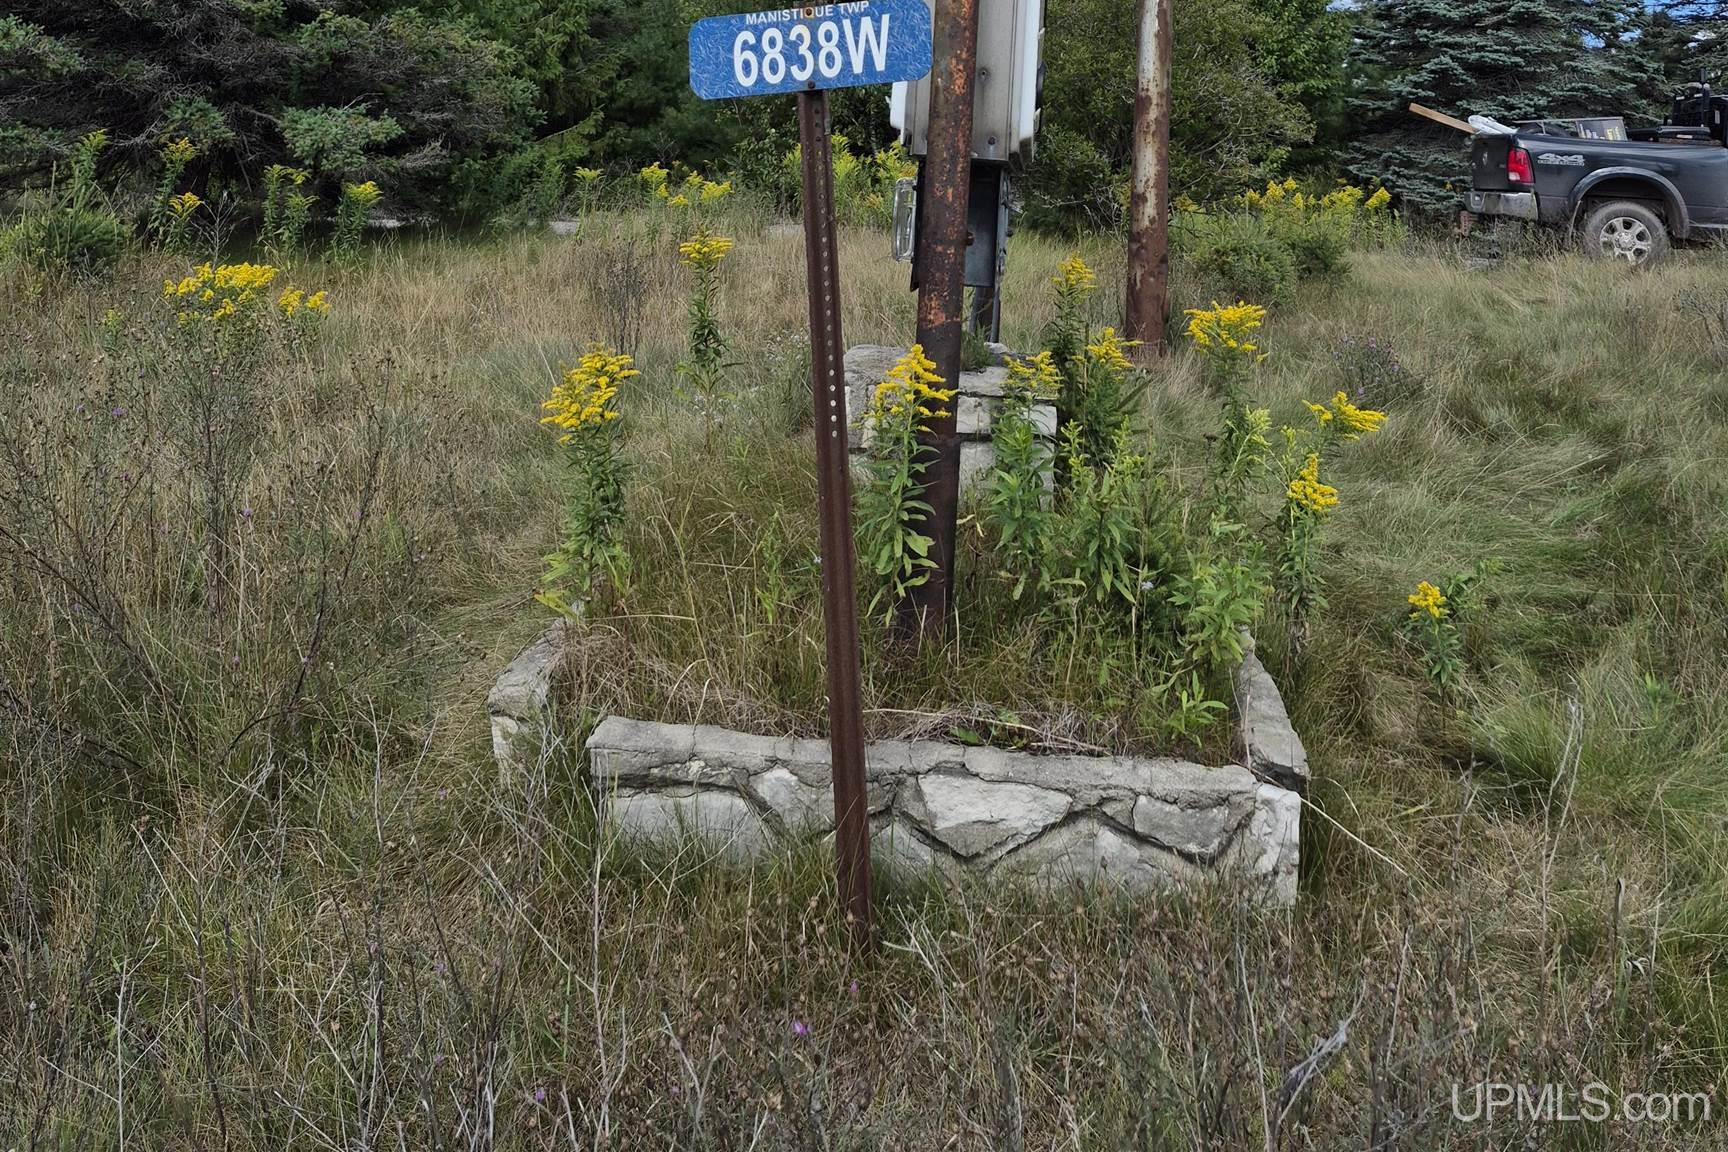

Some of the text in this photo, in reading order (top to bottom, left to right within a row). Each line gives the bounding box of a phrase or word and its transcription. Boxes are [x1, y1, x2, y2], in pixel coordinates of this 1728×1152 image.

[746, 1, 869, 25] MANISTIQUE TWP
[733, 14, 890, 88] 6838W
